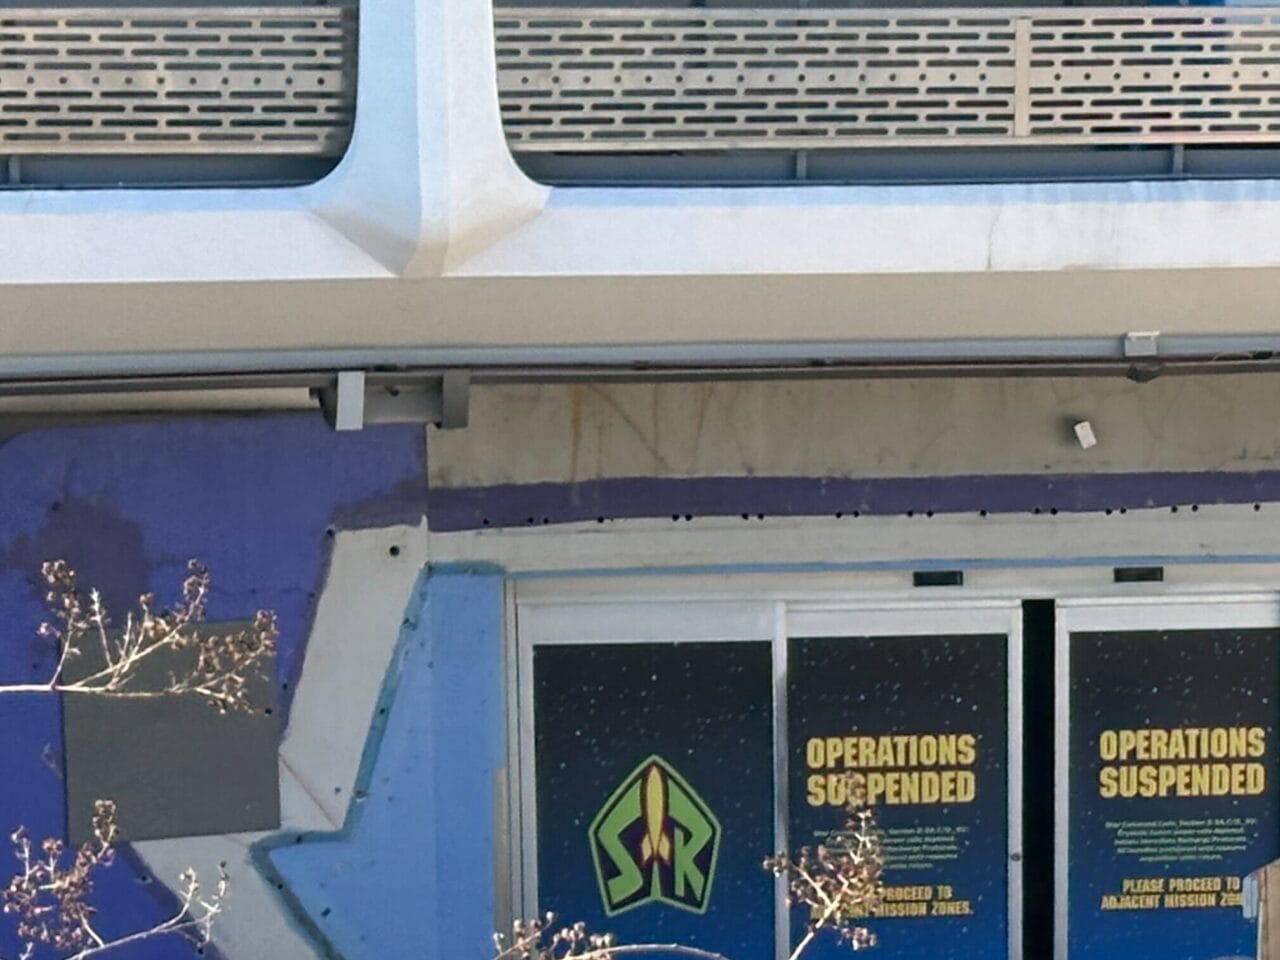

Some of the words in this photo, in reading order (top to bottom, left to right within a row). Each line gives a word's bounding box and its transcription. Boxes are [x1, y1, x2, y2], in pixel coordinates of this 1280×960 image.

[806, 733, 977, 769] OPERATIONS
[1099, 727, 1266, 761] OPERATIONS
[1099, 762, 1266, 798] SUSPENDED
[880, 885, 933, 901] PROCEED
[937, 885, 953, 899] TO
[1122, 878, 1165, 893] PLEASE
[1168, 876, 1222, 892] PROCEED
[1226, 876, 1241, 891] TO
[874, 901, 928, 917] MISSION
[932, 900, 974, 915] ZONES.
[1100, 894, 1161, 910] ADJACENT
[1164, 892, 1216, 908] MISSION
